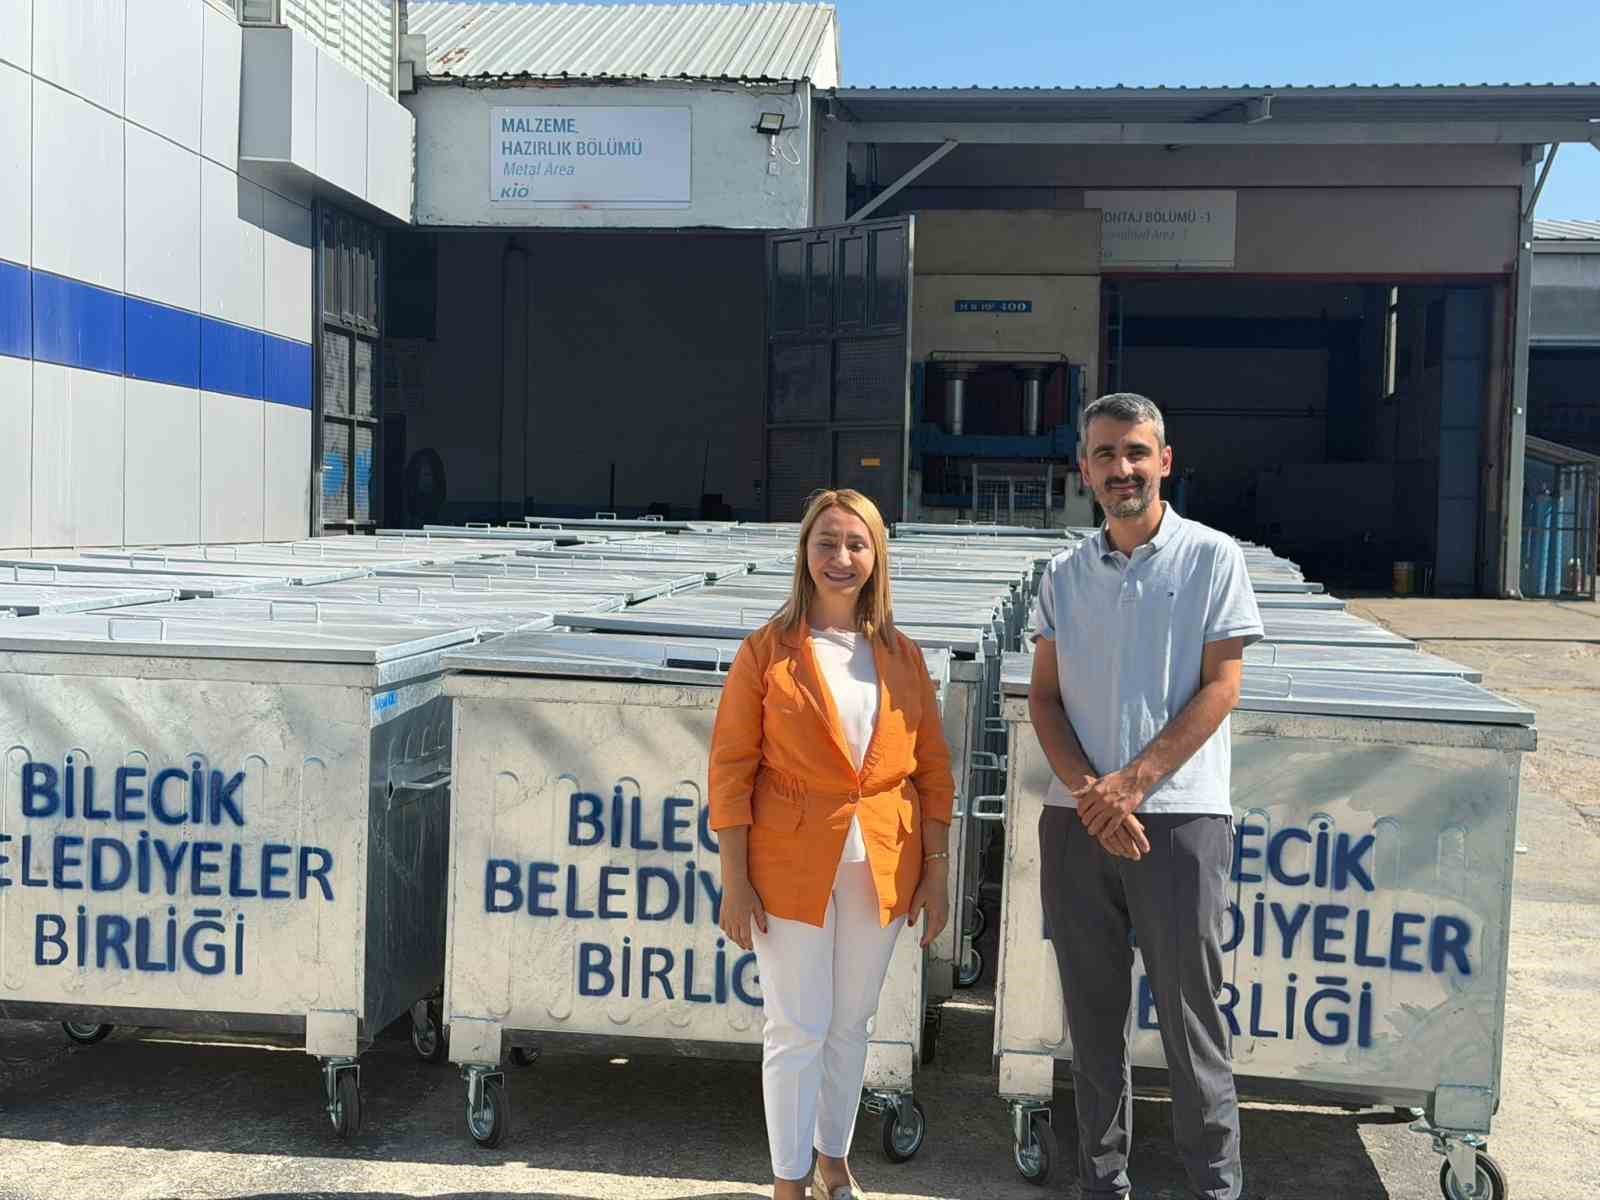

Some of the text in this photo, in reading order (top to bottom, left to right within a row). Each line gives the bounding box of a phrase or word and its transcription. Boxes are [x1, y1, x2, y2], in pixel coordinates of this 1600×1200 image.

[502, 137, 643, 156] HAZIRLIK BÖLÜMÜ
[504, 161, 576, 176] Metal Area
[1145, 208, 1197, 223] BÖLÜMÜ
[21, 755, 247, 826] BİLECİK
[35, 904, 245, 976] BİRLİĞİ
